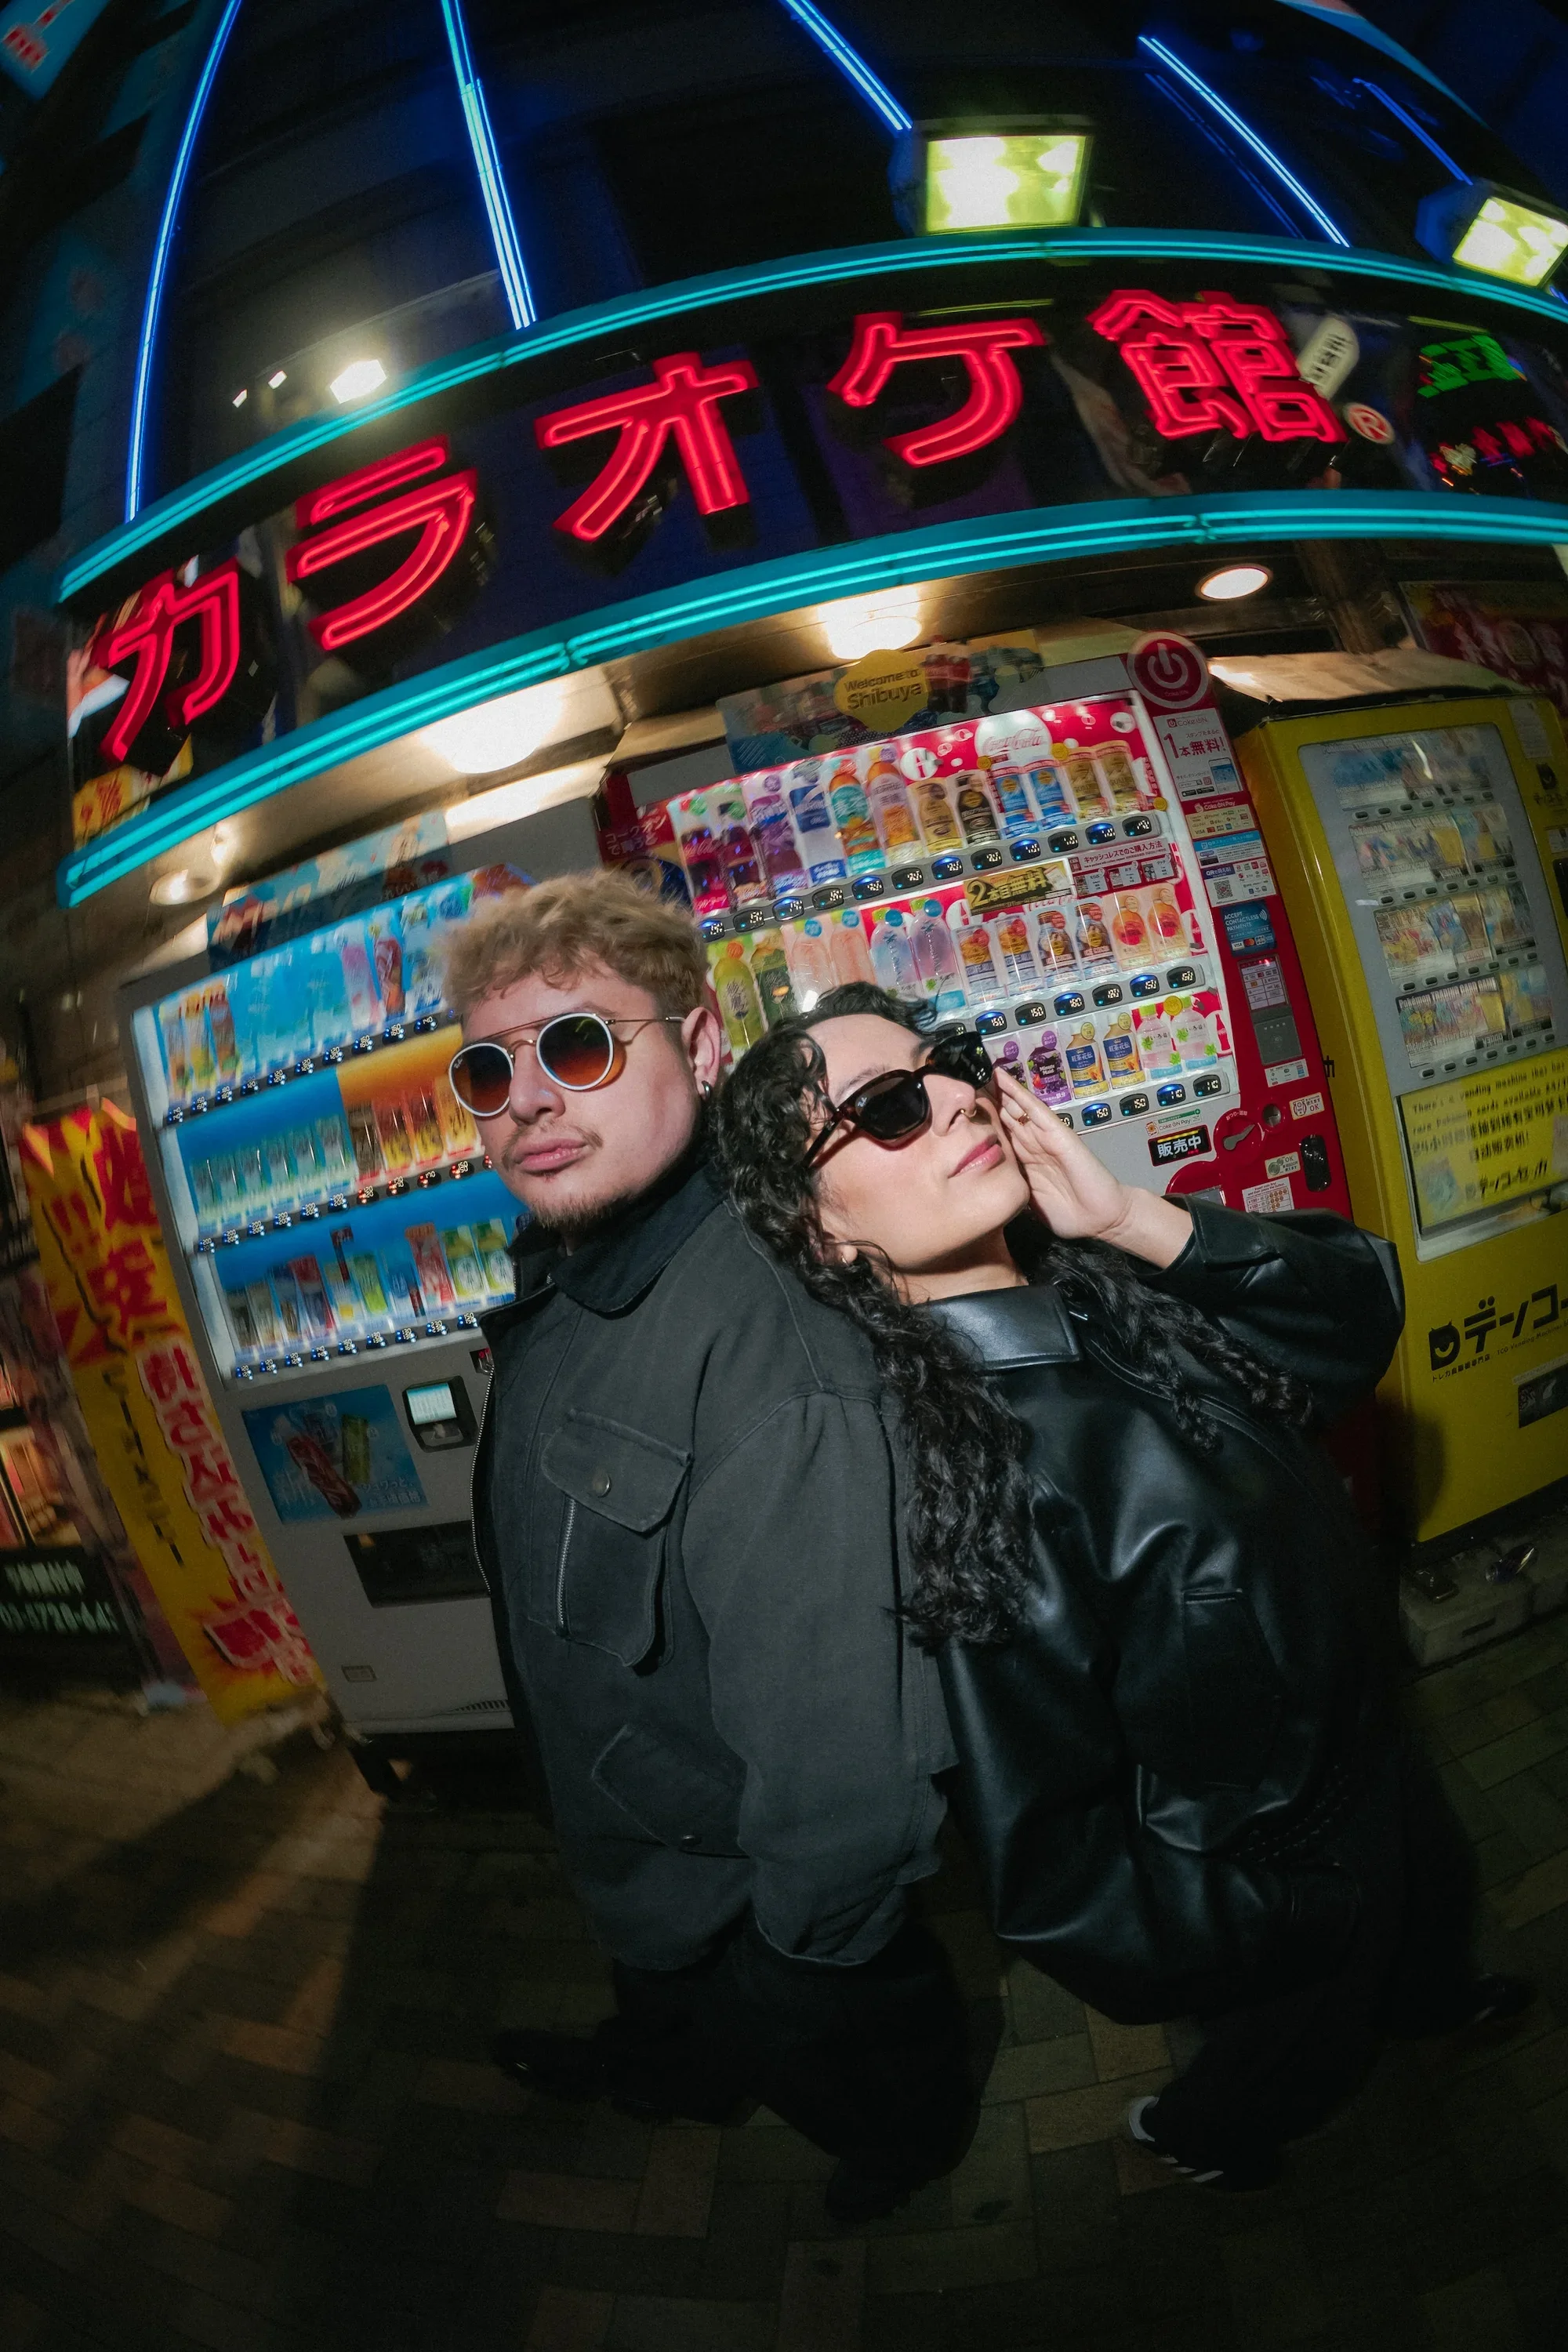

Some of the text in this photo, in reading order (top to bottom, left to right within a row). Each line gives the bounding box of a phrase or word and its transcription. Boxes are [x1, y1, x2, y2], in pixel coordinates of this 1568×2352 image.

[99, 287, 1348, 762] カラオケ館
[844, 672, 905, 691] Welcome
[847, 683, 922, 710] Shibuya
[1178, 718, 1196, 727] Coke
[1083, 840, 1163, 863] キャッシュレスでのご購入方法
[1224, 911, 1243, 920] ACCEPT
[1225, 914, 1259, 926] CONTACTLESS
[1226, 922, 1252, 931] PAYMENTS
[1398, 993, 1431, 1009] Pokémon
[1431, 986, 1460, 1002] TRADING
[1460, 981, 1478, 994] CARD
[1030, 1007, 1044, 1017] 150
[1109, 1043, 1131, 1052] 紅茶花伝
[1071, 1052, 1093, 1062] 紅茶花伝
[1207, 1079, 1219, 1091] 110
[1171, 1089, 1183, 1099] 110
[1461, 1083, 1491, 1101] vending
[1134, 1098, 1146, 1109] 150
[1309, 1103, 1319, 1112] OK
[1096, 1107, 1109, 1118] 150
[1157, 1134, 1202, 1159] 販売中
[1497, 1346, 1509, 1355] TCG
[1510, 1335, 1535, 1351] Vending
